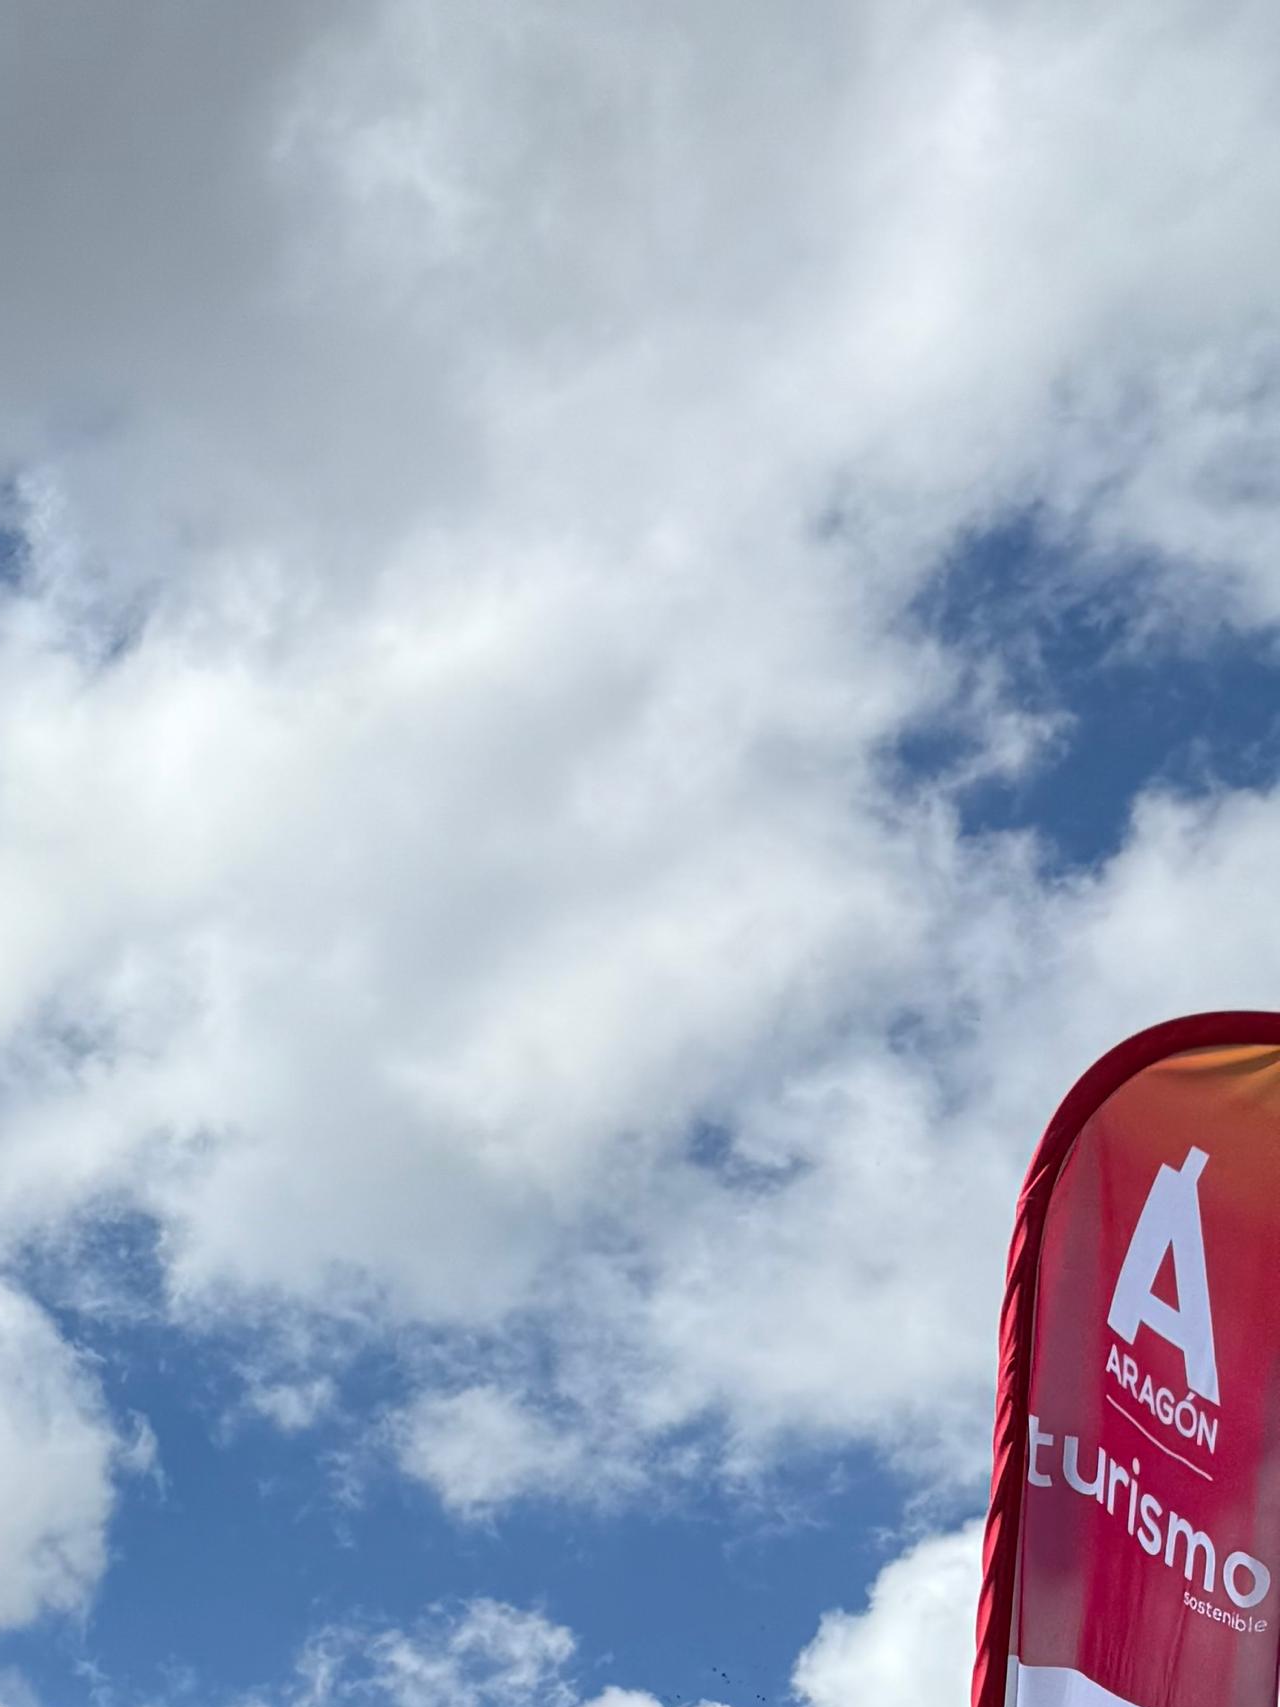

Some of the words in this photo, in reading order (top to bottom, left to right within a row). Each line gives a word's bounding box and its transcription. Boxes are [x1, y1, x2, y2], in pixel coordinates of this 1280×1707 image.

[1105, 1343, 1218, 1454] ARAGÓN
[1028, 1414, 1270, 1609] turismo
[1183, 1591, 1268, 1634] sostenible
